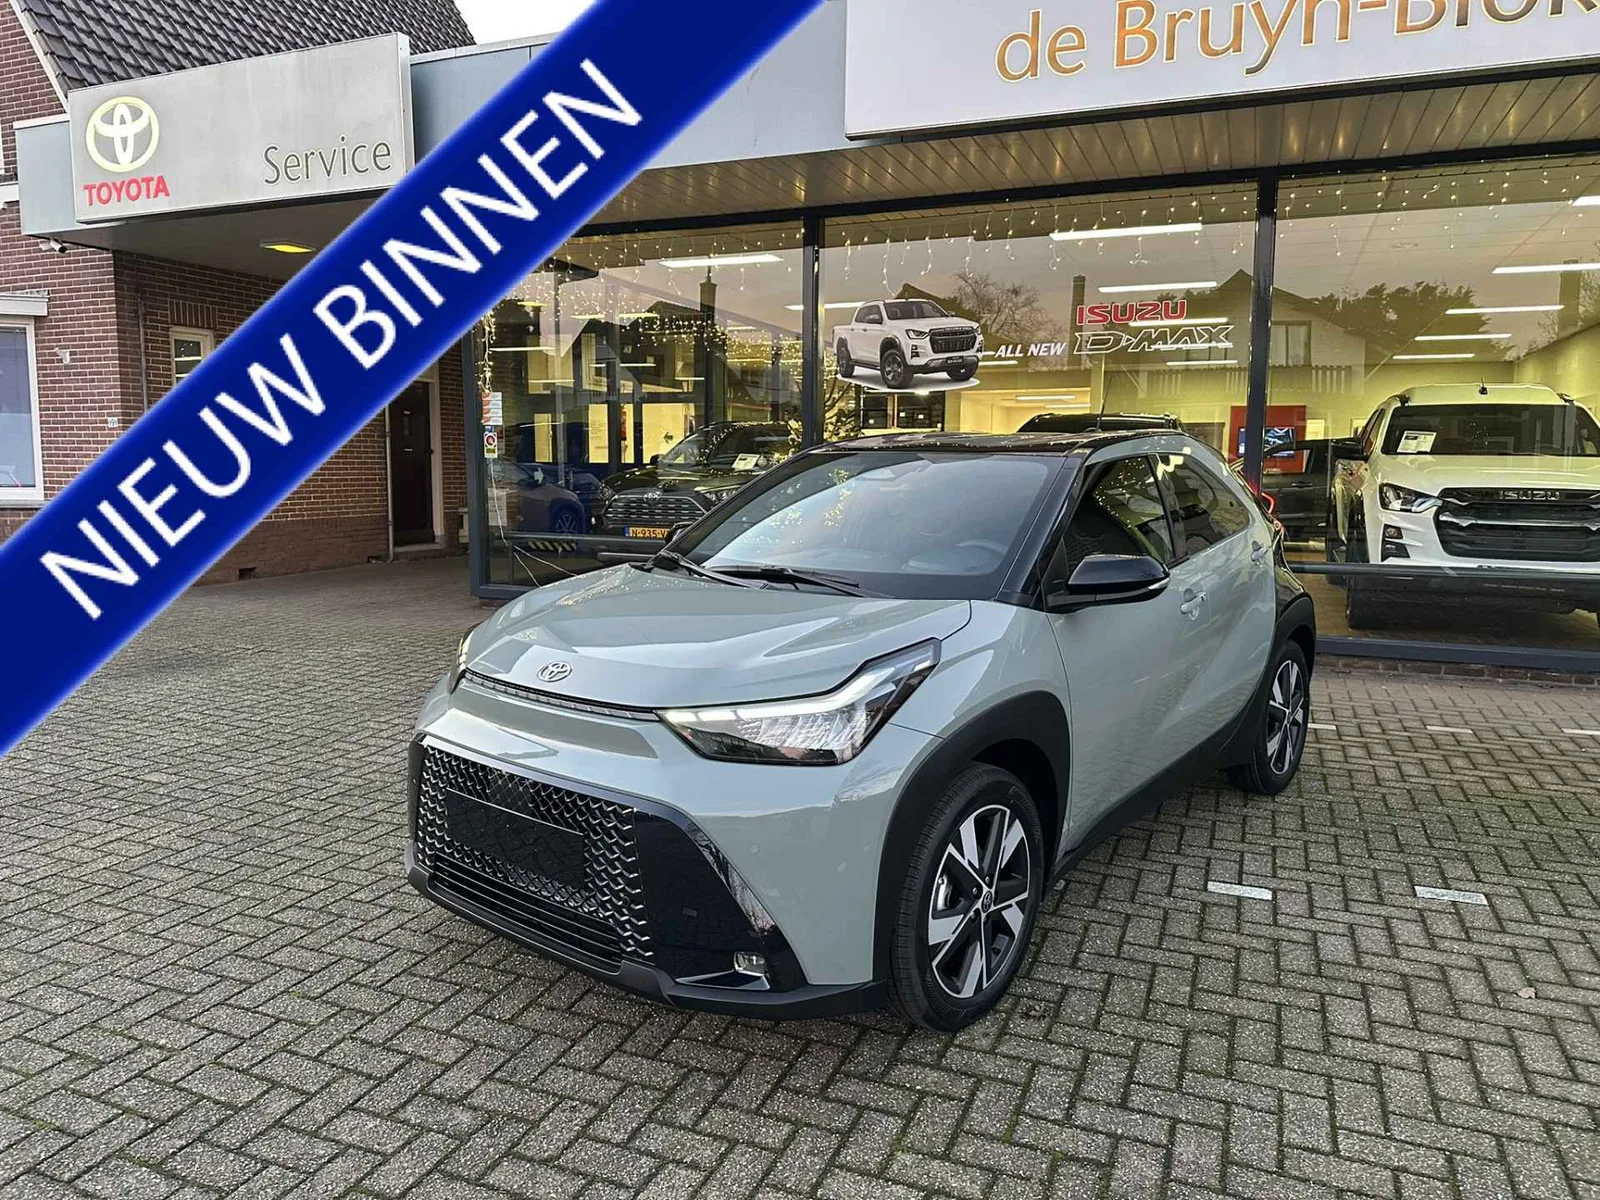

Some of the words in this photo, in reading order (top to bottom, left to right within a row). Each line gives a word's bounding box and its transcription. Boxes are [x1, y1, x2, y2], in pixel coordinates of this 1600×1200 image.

[995, 9, 1087, 82] de
[1114, 0, 1600, 77] Bruyn-B
[264, 134, 392, 185] Service
[84, 175, 170, 206] TOYOTA
[1076, 300, 1187, 326] ISUZU
[995, 344, 1024, 358] ALL
[1027, 342, 1067, 357] NEW
[1499, 490, 1560, 501] ISUZU
